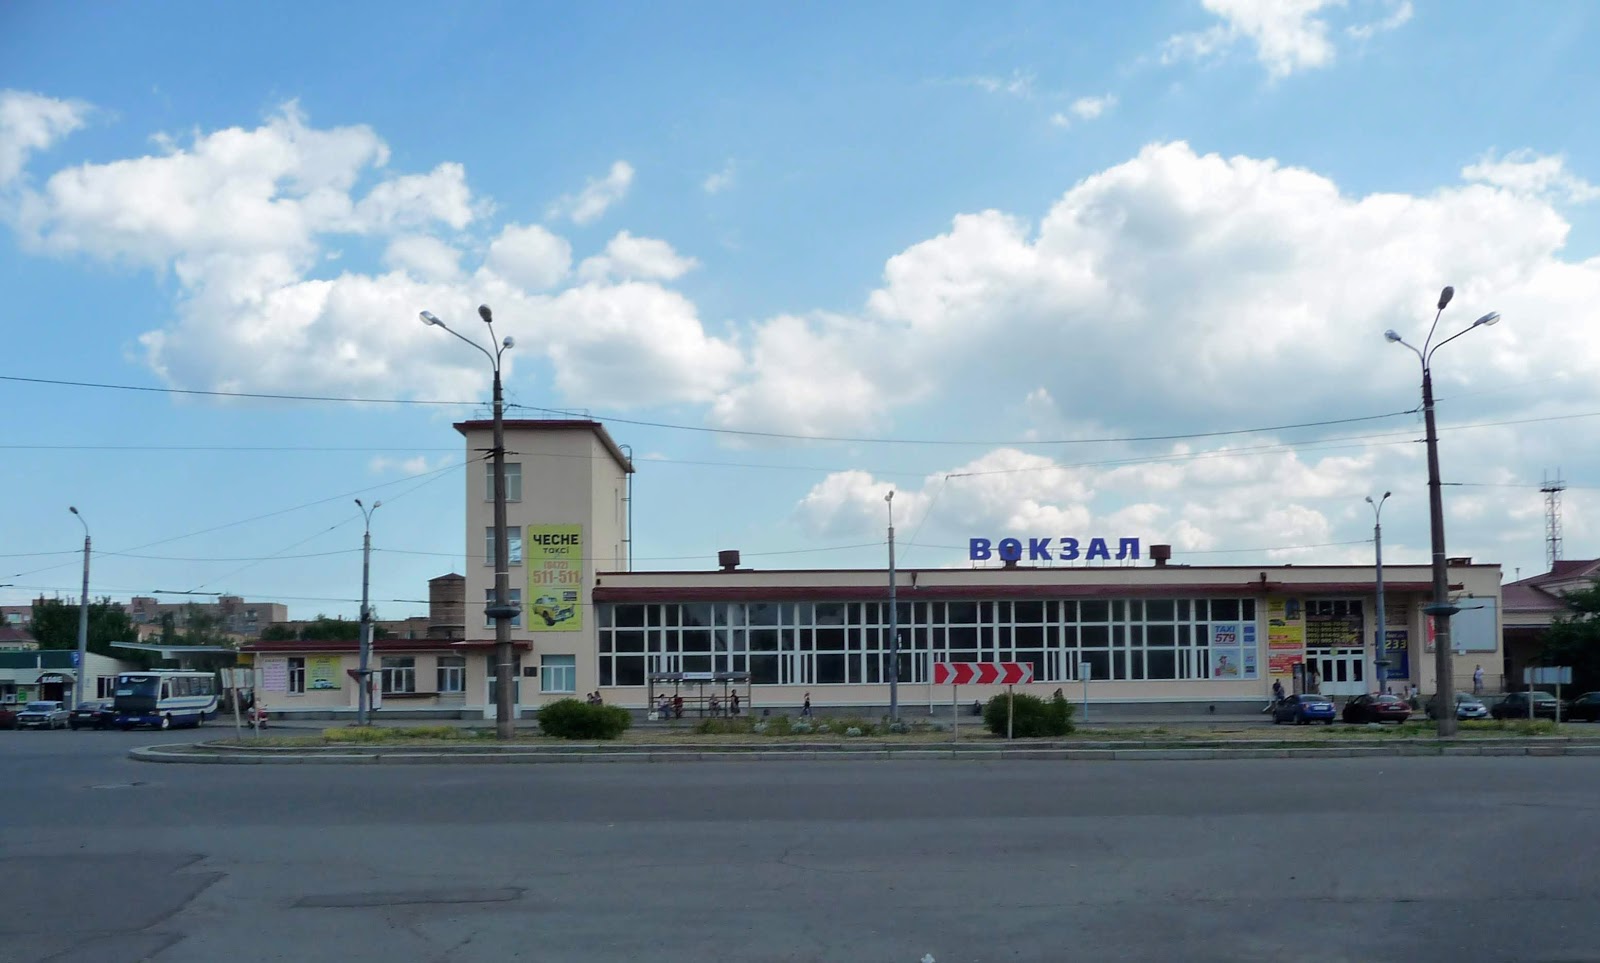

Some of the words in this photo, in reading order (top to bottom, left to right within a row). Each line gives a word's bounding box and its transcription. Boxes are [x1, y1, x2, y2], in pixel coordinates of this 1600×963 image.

[533, 534, 579, 545] ЧЕСНЕ
[969, 537, 1140, 560] ВОКЗАЛ
[533, 570, 579, 584] 511-511
[1215, 633, 1236, 643] 579
